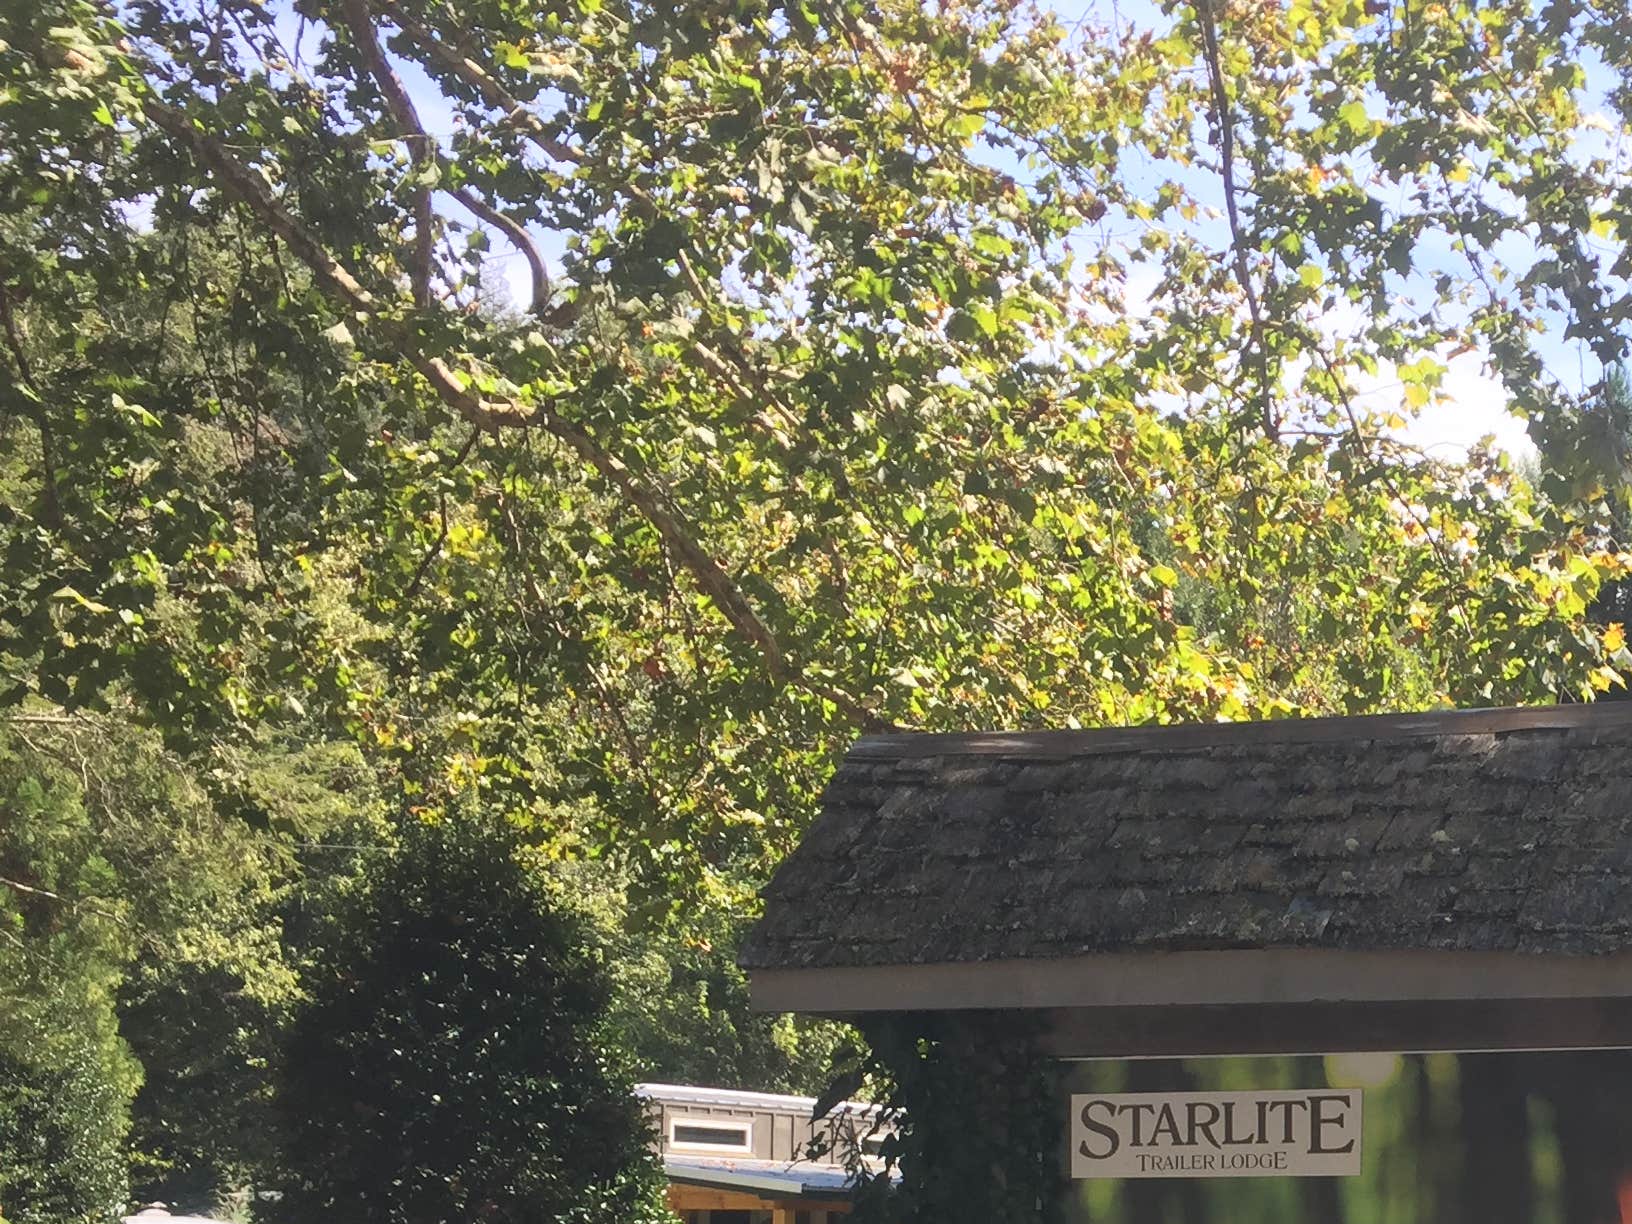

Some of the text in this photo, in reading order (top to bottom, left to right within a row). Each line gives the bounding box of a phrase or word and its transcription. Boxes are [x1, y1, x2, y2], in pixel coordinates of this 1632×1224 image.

[1079, 1095, 1355, 1160] STARLITE
[1136, 1151, 1288, 1172] TRAILER LODGE
